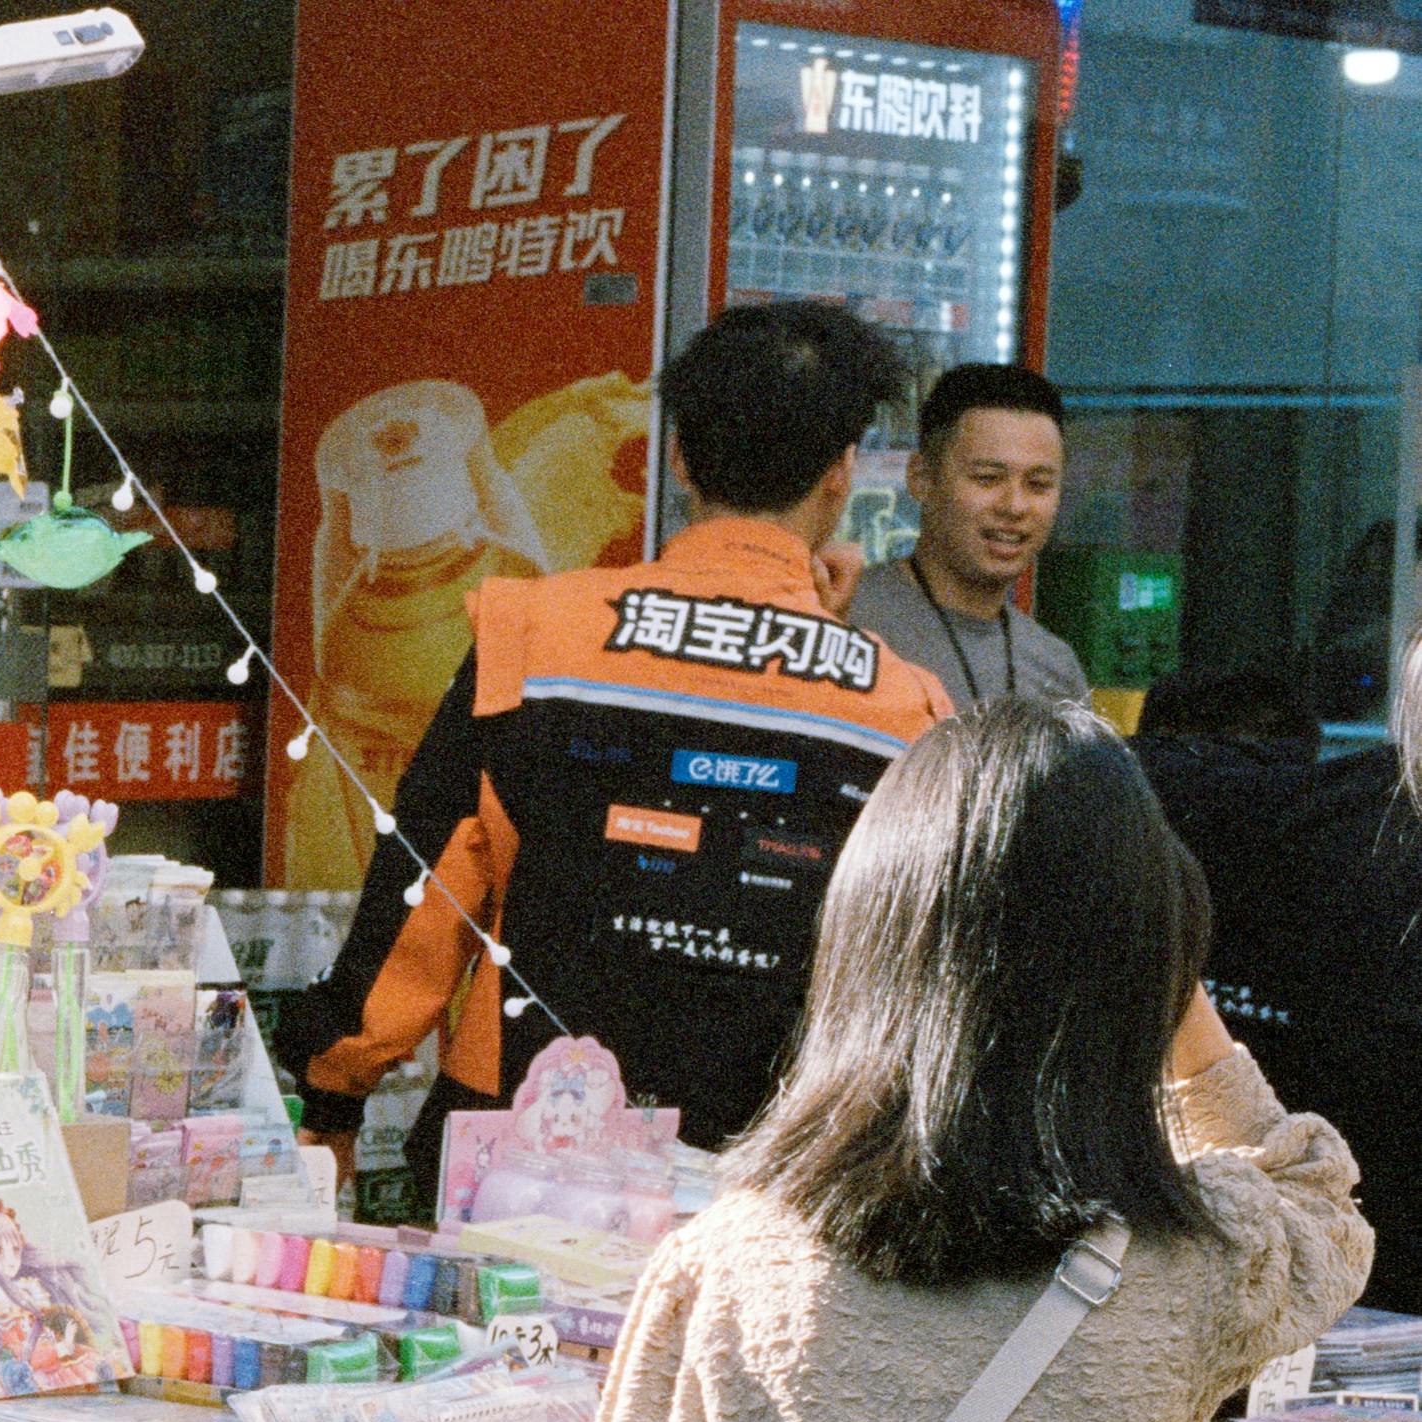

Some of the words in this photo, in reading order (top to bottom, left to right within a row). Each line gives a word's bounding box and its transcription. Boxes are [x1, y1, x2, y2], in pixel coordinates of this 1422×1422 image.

[838, 69, 982, 143] 东鹏饮料
[323, 113, 630, 232] 累了困了
[318, 207, 628, 303] 喝东鹏特饮
[615, 592, 876, 689] 淘宝闪购
[715, 759, 780, 788] 饿了么
[124, 1215, 181, 1280] 5元
